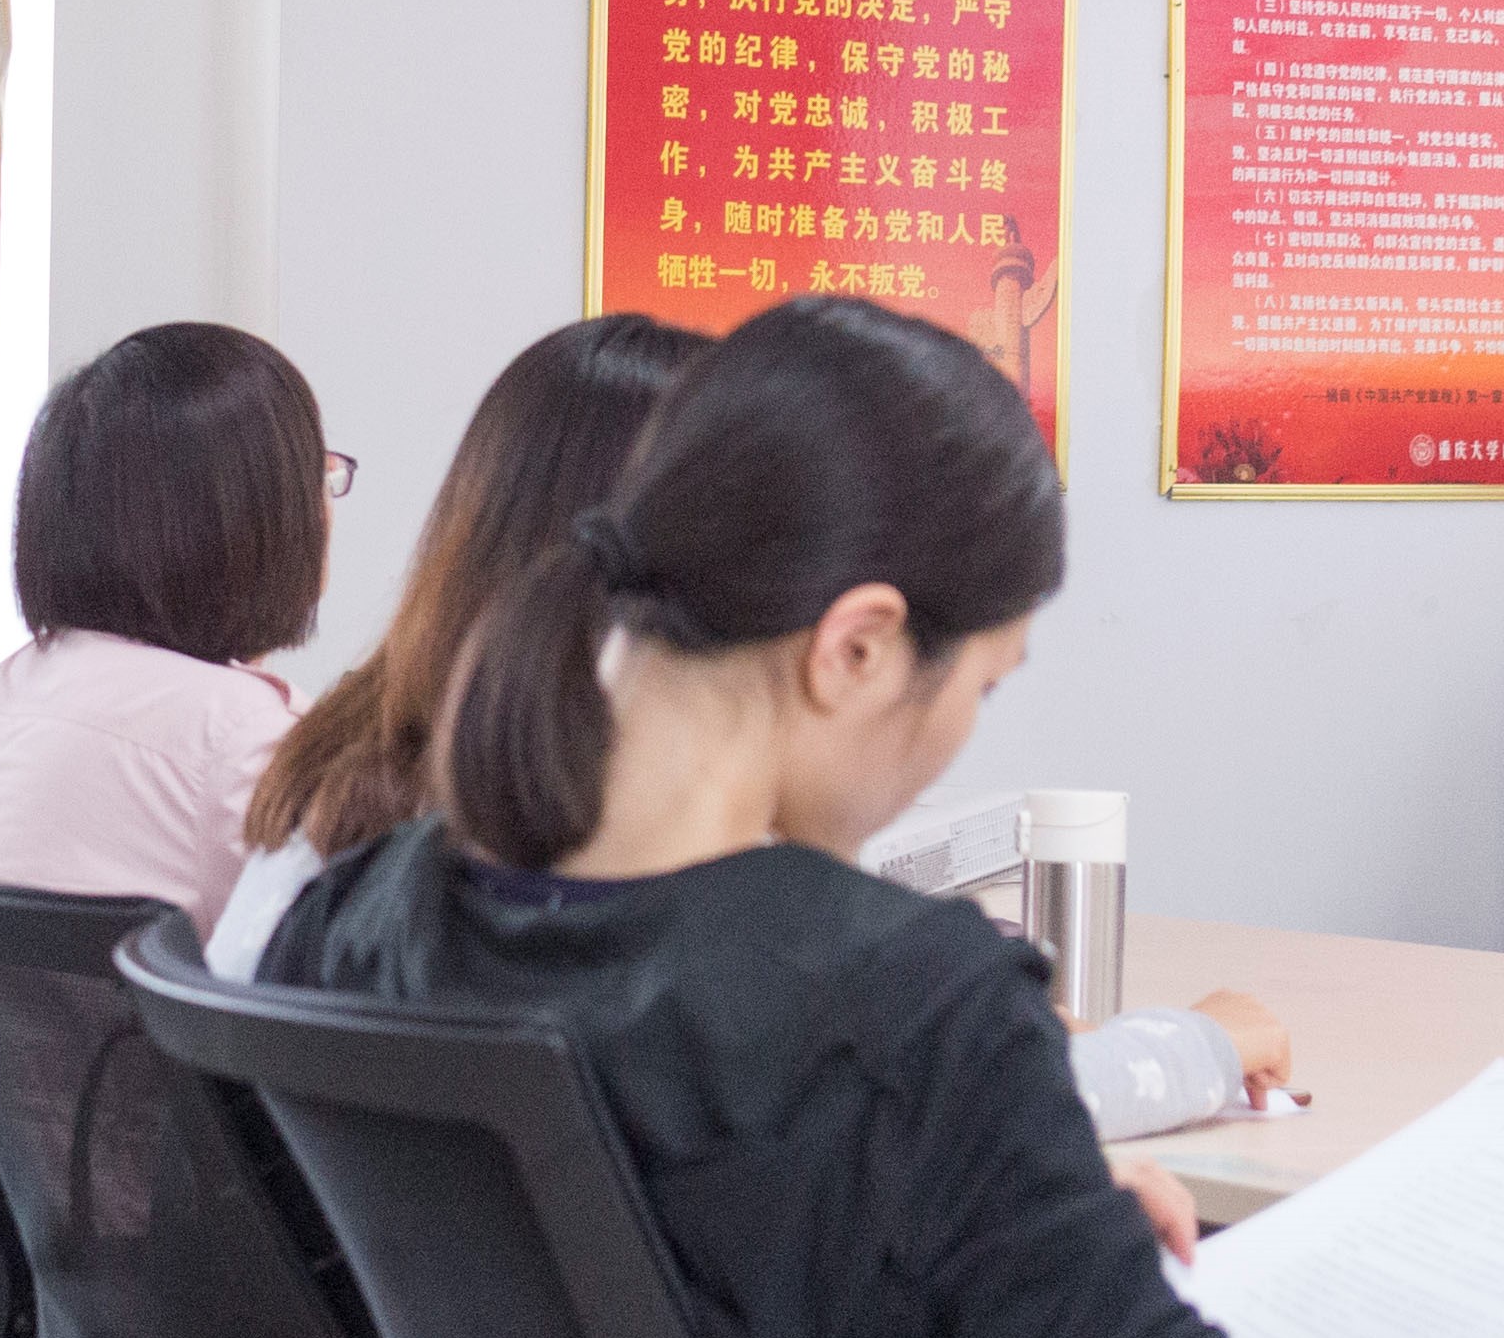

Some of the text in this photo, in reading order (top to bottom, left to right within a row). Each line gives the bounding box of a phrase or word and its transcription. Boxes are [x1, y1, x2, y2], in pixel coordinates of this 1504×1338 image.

[661, 27, 1011, 84] 党的纪律，保守党的秘
[660, 83, 1010, 137] 密，对党忠诚，积极工
[659, 139, 1008, 194] 作，为共产主义奋斗终
[659, 196, 1008, 248] 身，随时准备为党和人民
[657, 252, 940, 300] 牺牲一切，永不叛党。
